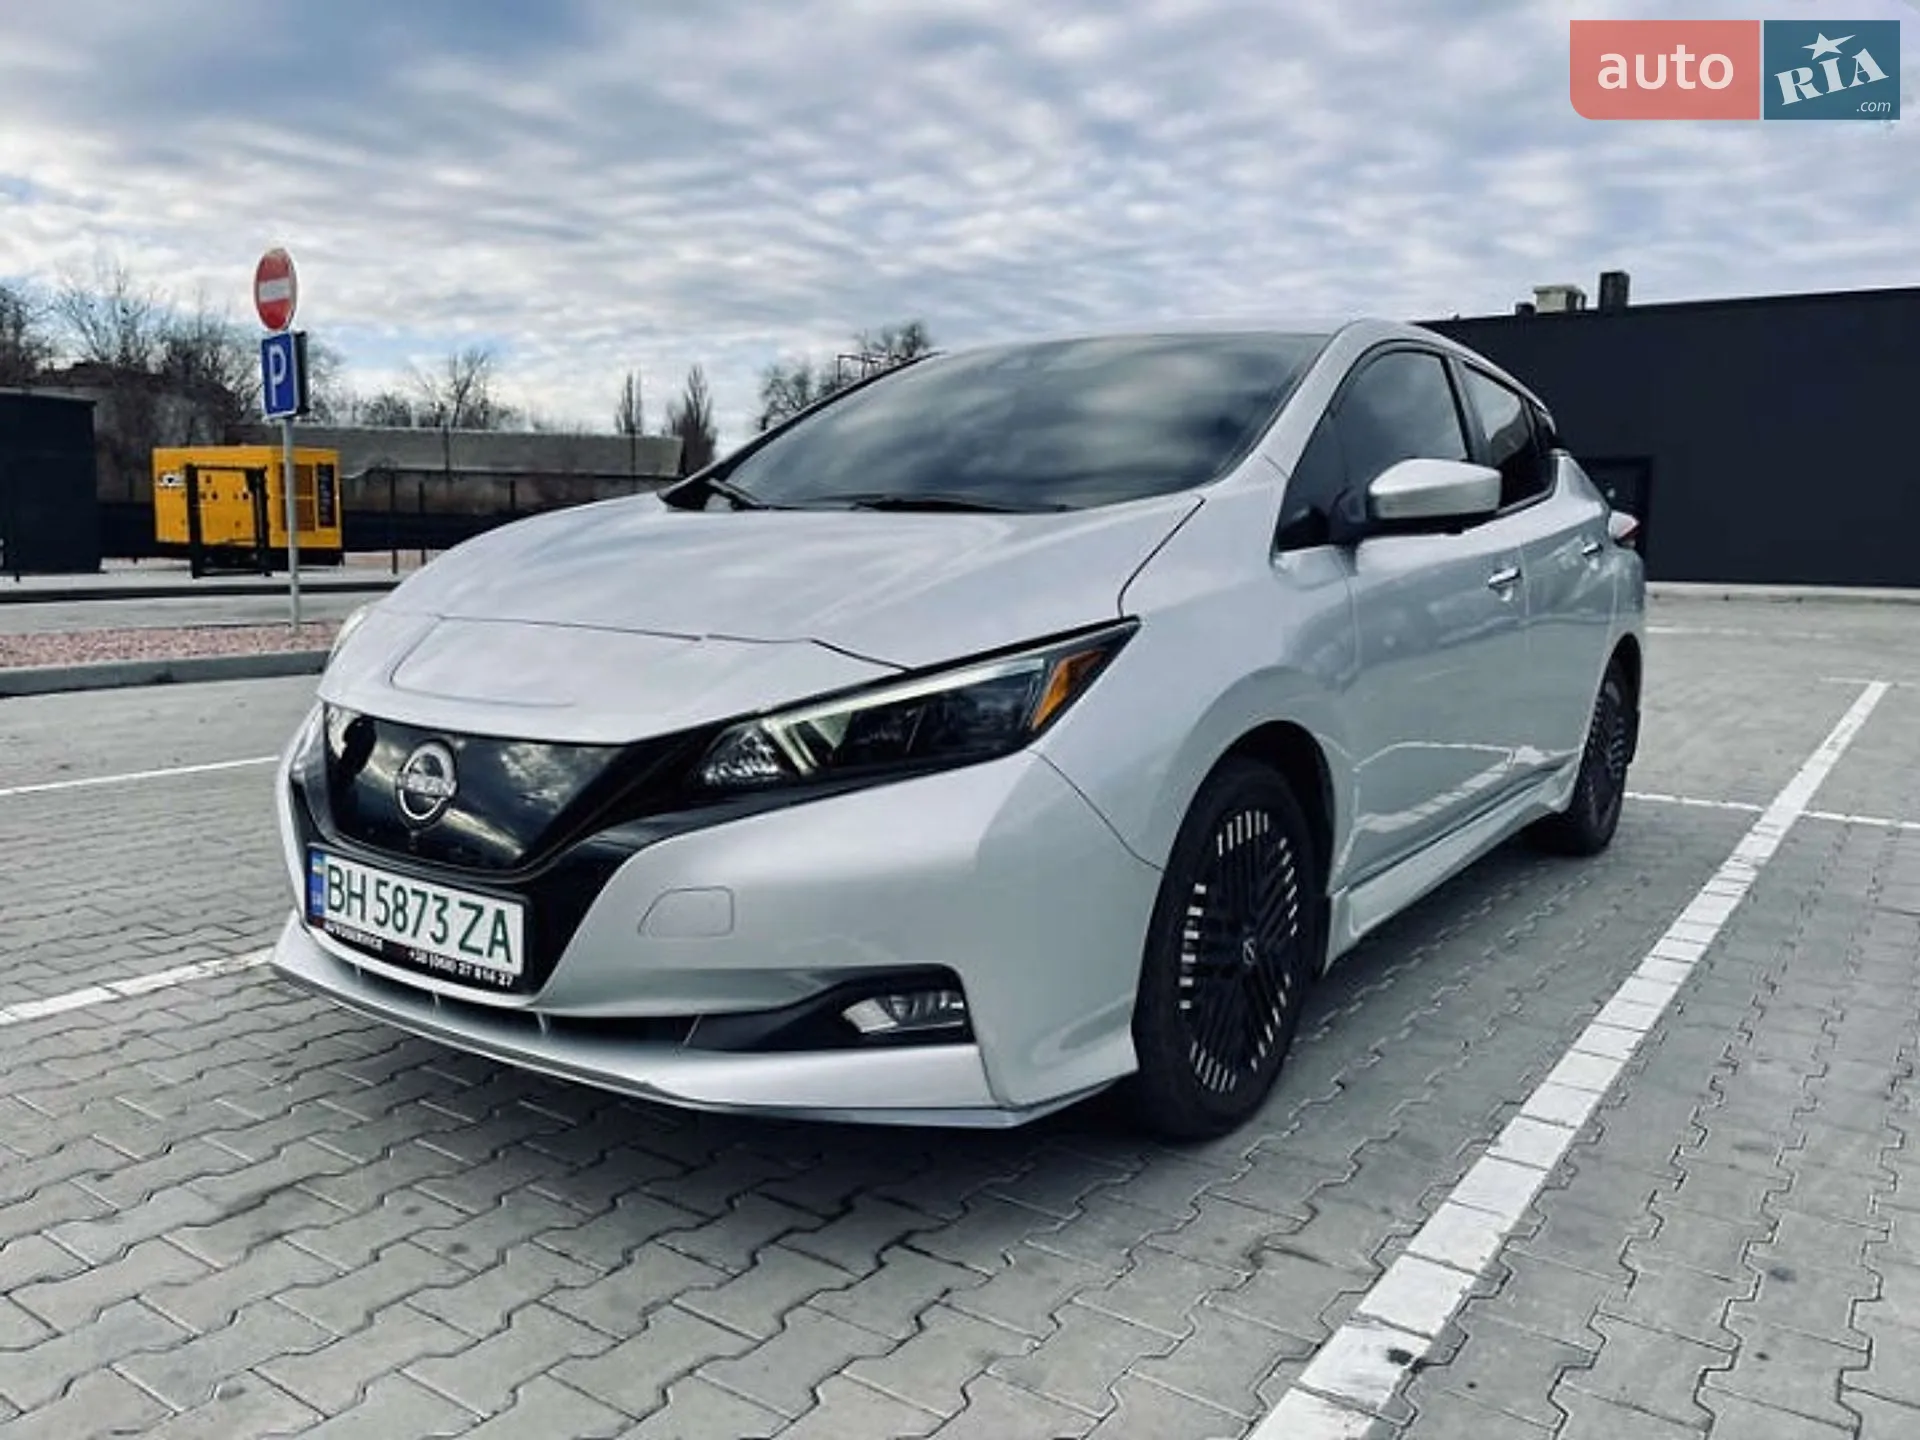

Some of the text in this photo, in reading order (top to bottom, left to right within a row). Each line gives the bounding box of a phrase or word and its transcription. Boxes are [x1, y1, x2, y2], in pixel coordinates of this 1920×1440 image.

[268, 344, 286, 407] P
[327, 863, 367, 923] BH
[374, 879, 449, 945] 5873
[458, 901, 513, 964] ZA
